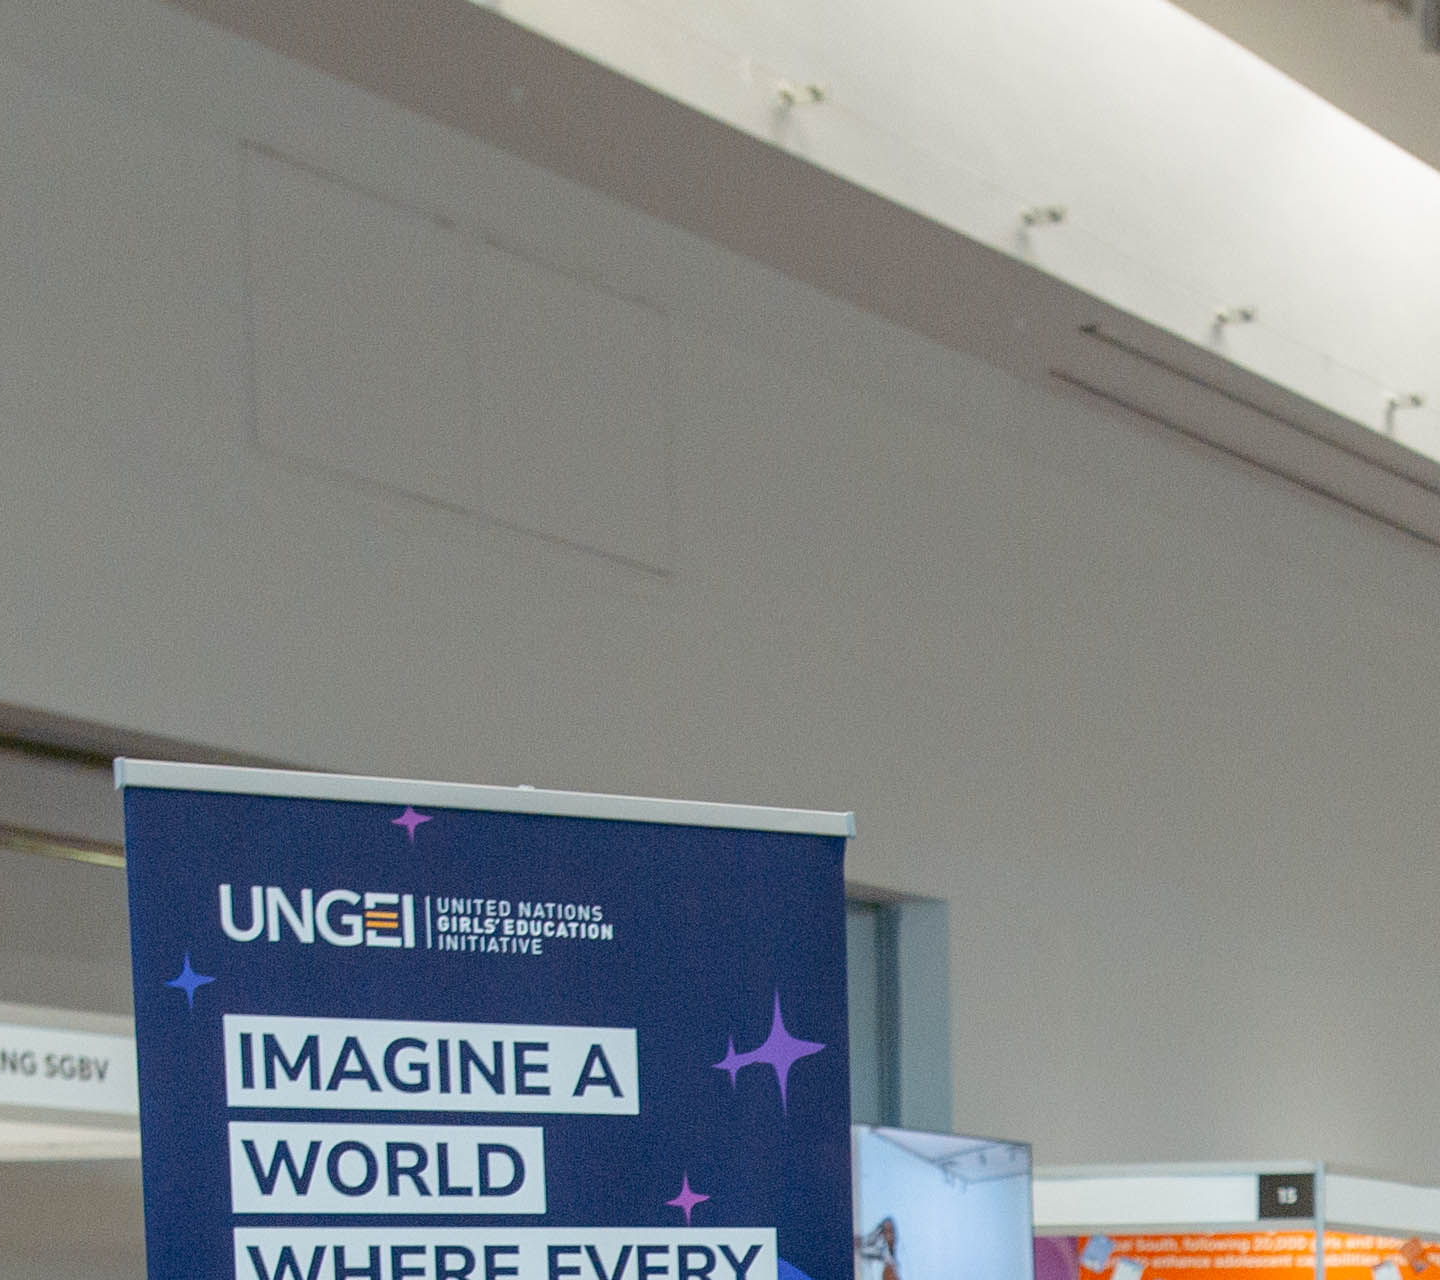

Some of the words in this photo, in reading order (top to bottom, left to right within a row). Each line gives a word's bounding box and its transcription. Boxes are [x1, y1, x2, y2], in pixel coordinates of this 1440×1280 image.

[220, 884, 415, 948] UNGEI
[436, 896, 512, 918] UNITED
[516, 898, 604, 923] NATIONS
[503, 919, 615, 941] EDUCATION
[437, 933, 545, 957] INITIATIVE
[44, 1054, 109, 1083] SGBV
[240, 1033, 551, 1096] IMAGINE
[573, 1044, 623, 1097] A
[242, 1140, 525, 1196] WORLD
